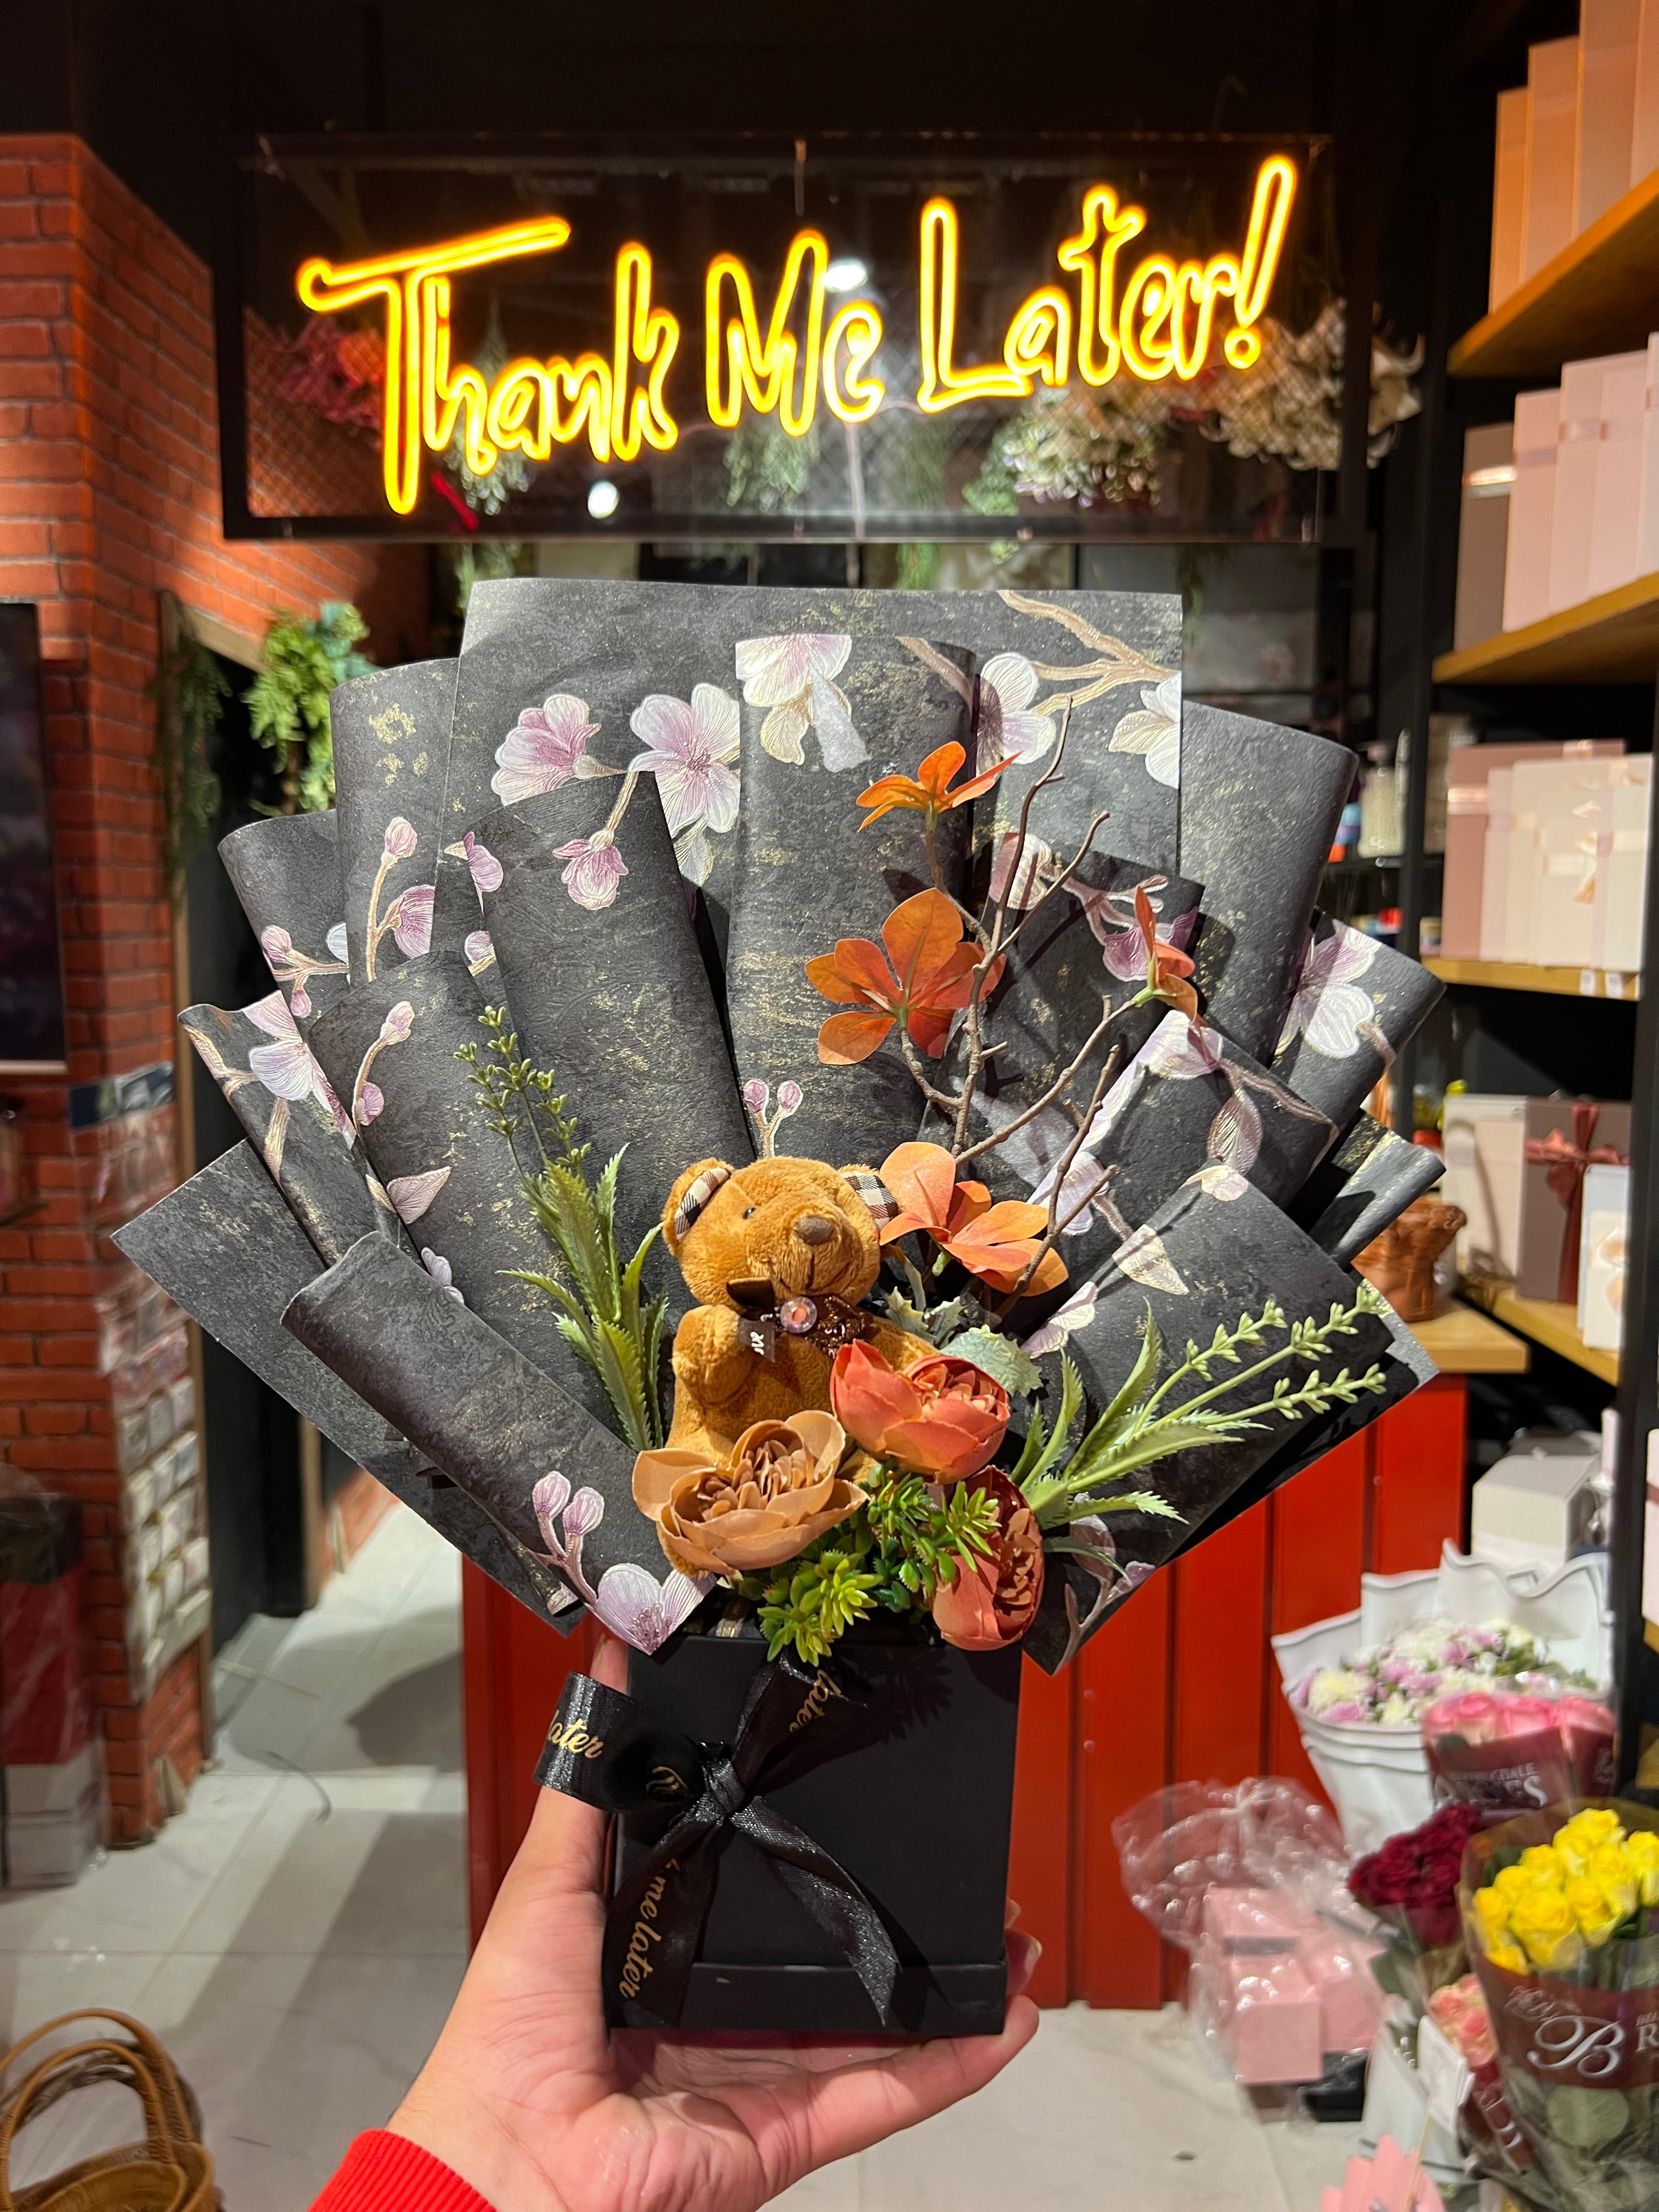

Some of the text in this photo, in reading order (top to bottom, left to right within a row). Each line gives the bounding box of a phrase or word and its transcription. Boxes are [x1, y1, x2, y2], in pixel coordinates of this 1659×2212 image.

[296, 154, 1298, 516] Thank Me Later!
[619, 1876, 667, 1999] me later
